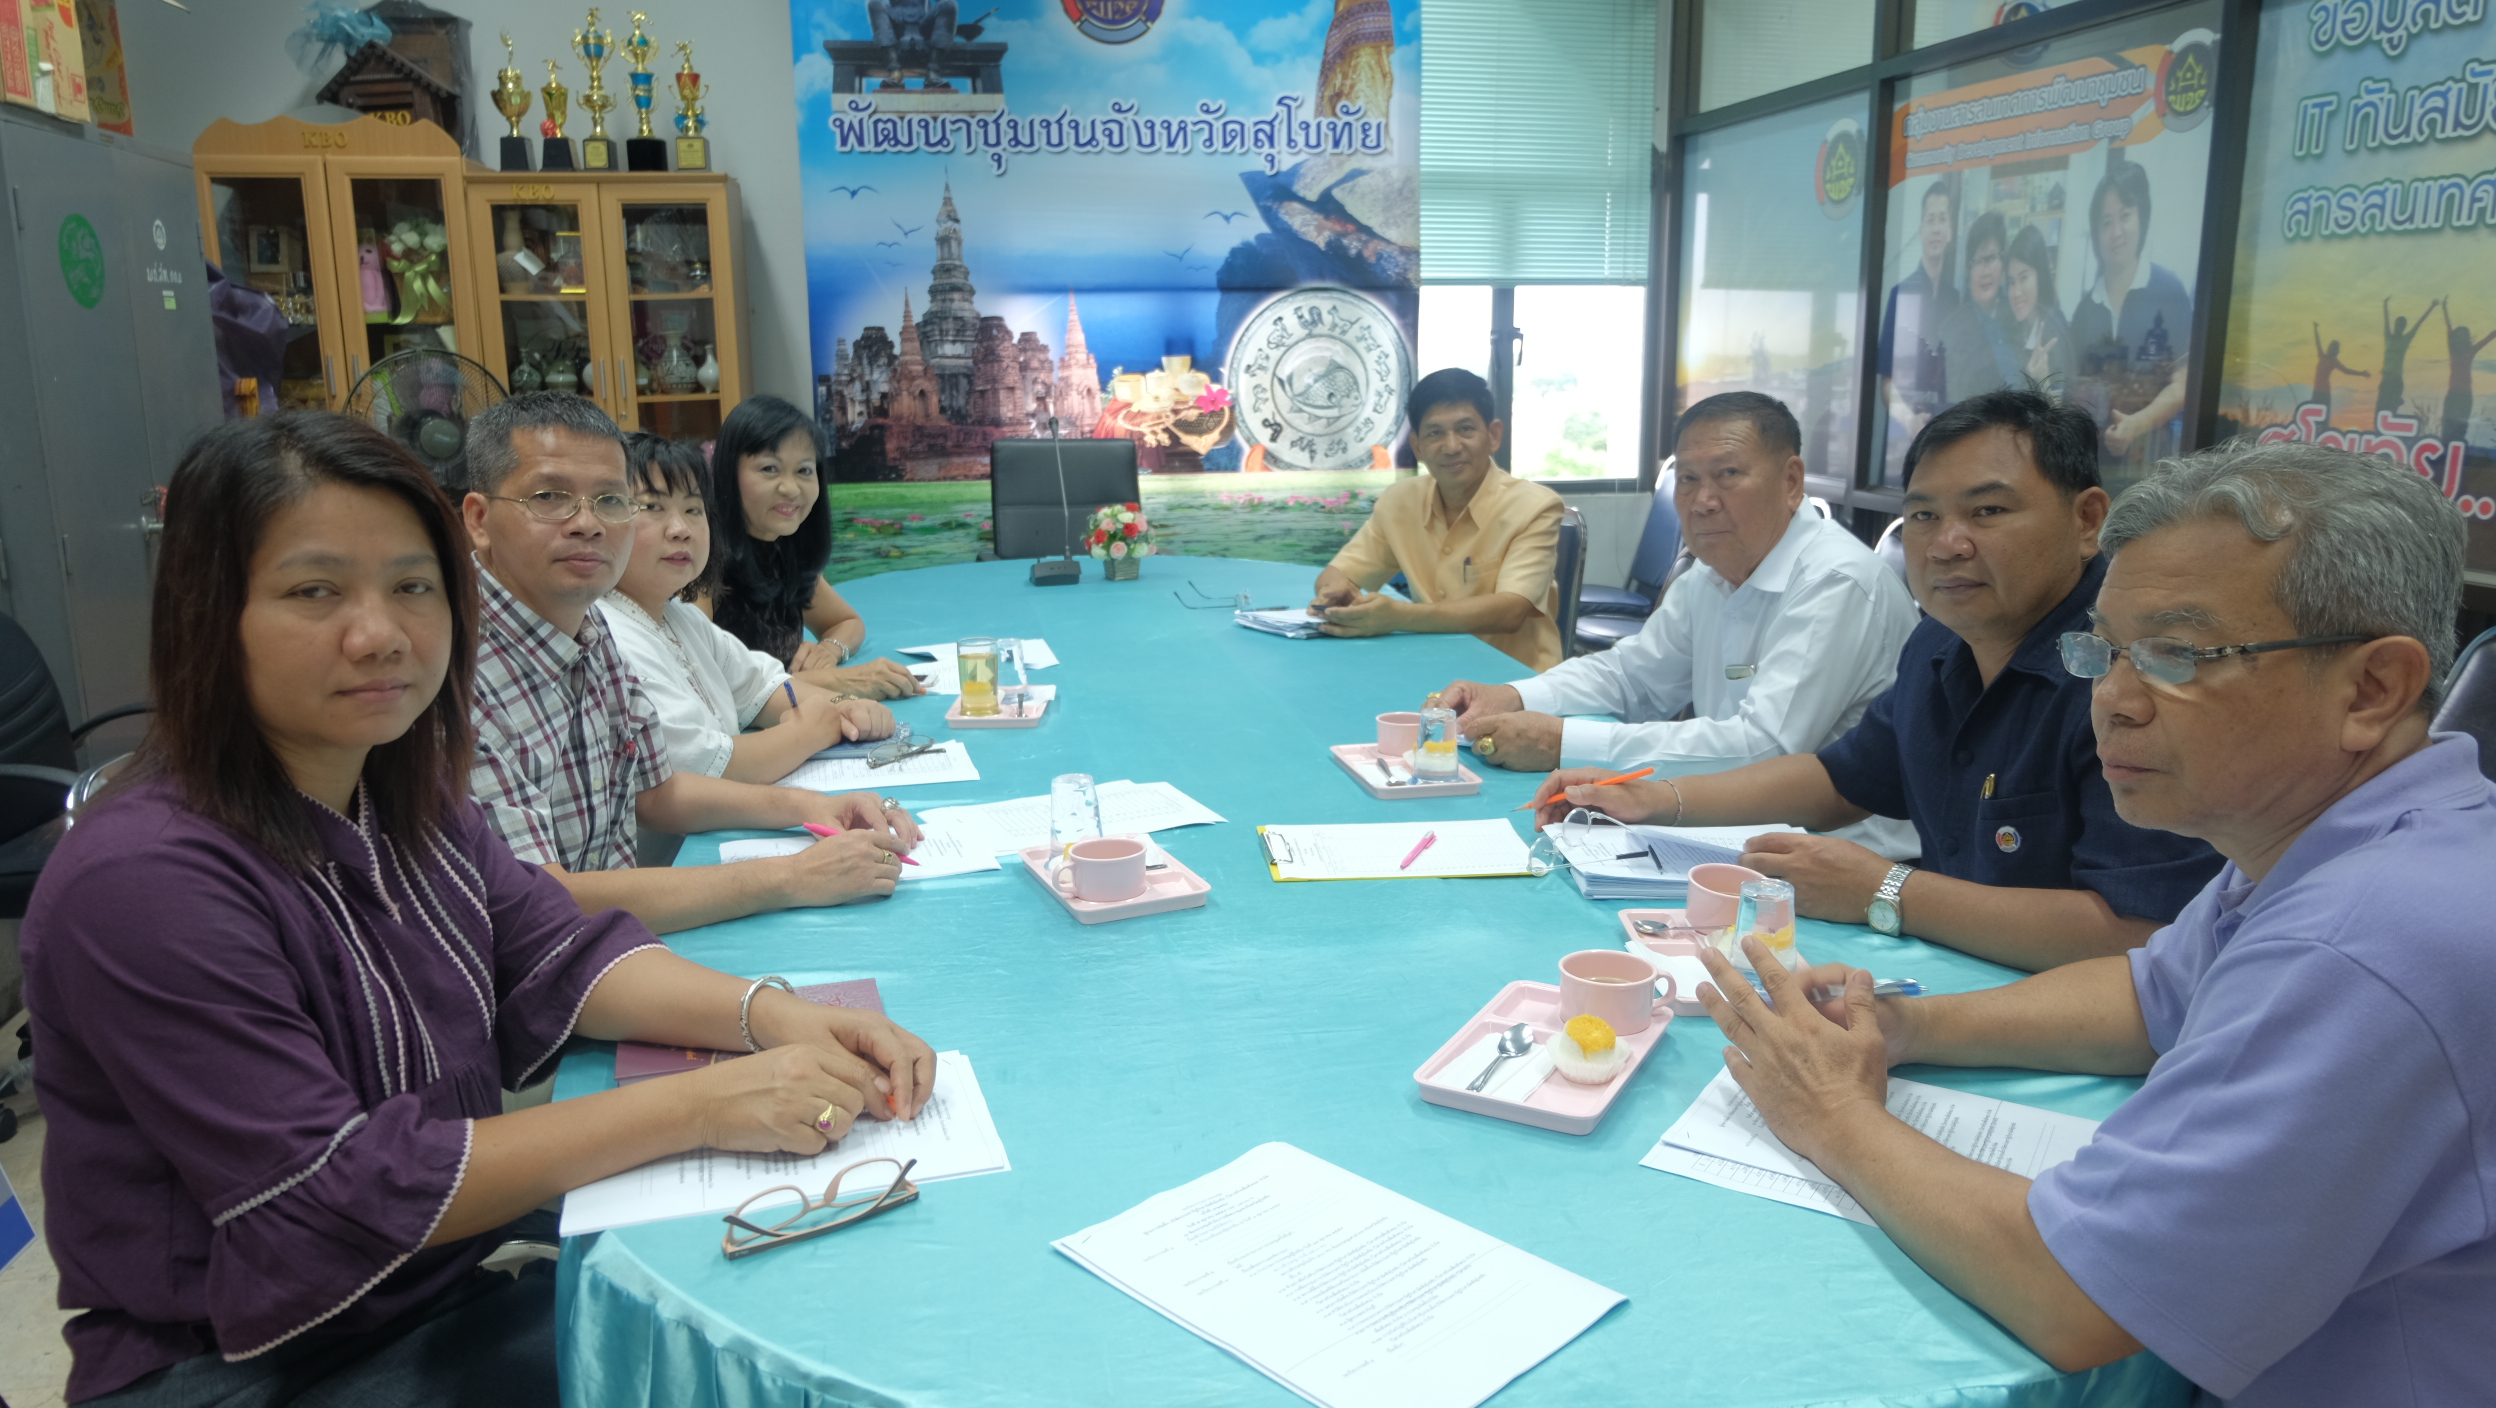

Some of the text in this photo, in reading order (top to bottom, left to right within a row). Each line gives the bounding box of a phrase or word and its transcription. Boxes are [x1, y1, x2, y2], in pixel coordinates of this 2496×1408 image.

[831, 94, 1386, 174] พัฒนาชุมชนจังหวัดสุโขทัย
[2091, 116, 2133, 140] Group
[2294, 94, 2339, 156] IT
[301, 130, 349, 148] KBO
[511, 183, 555, 200] KBO
